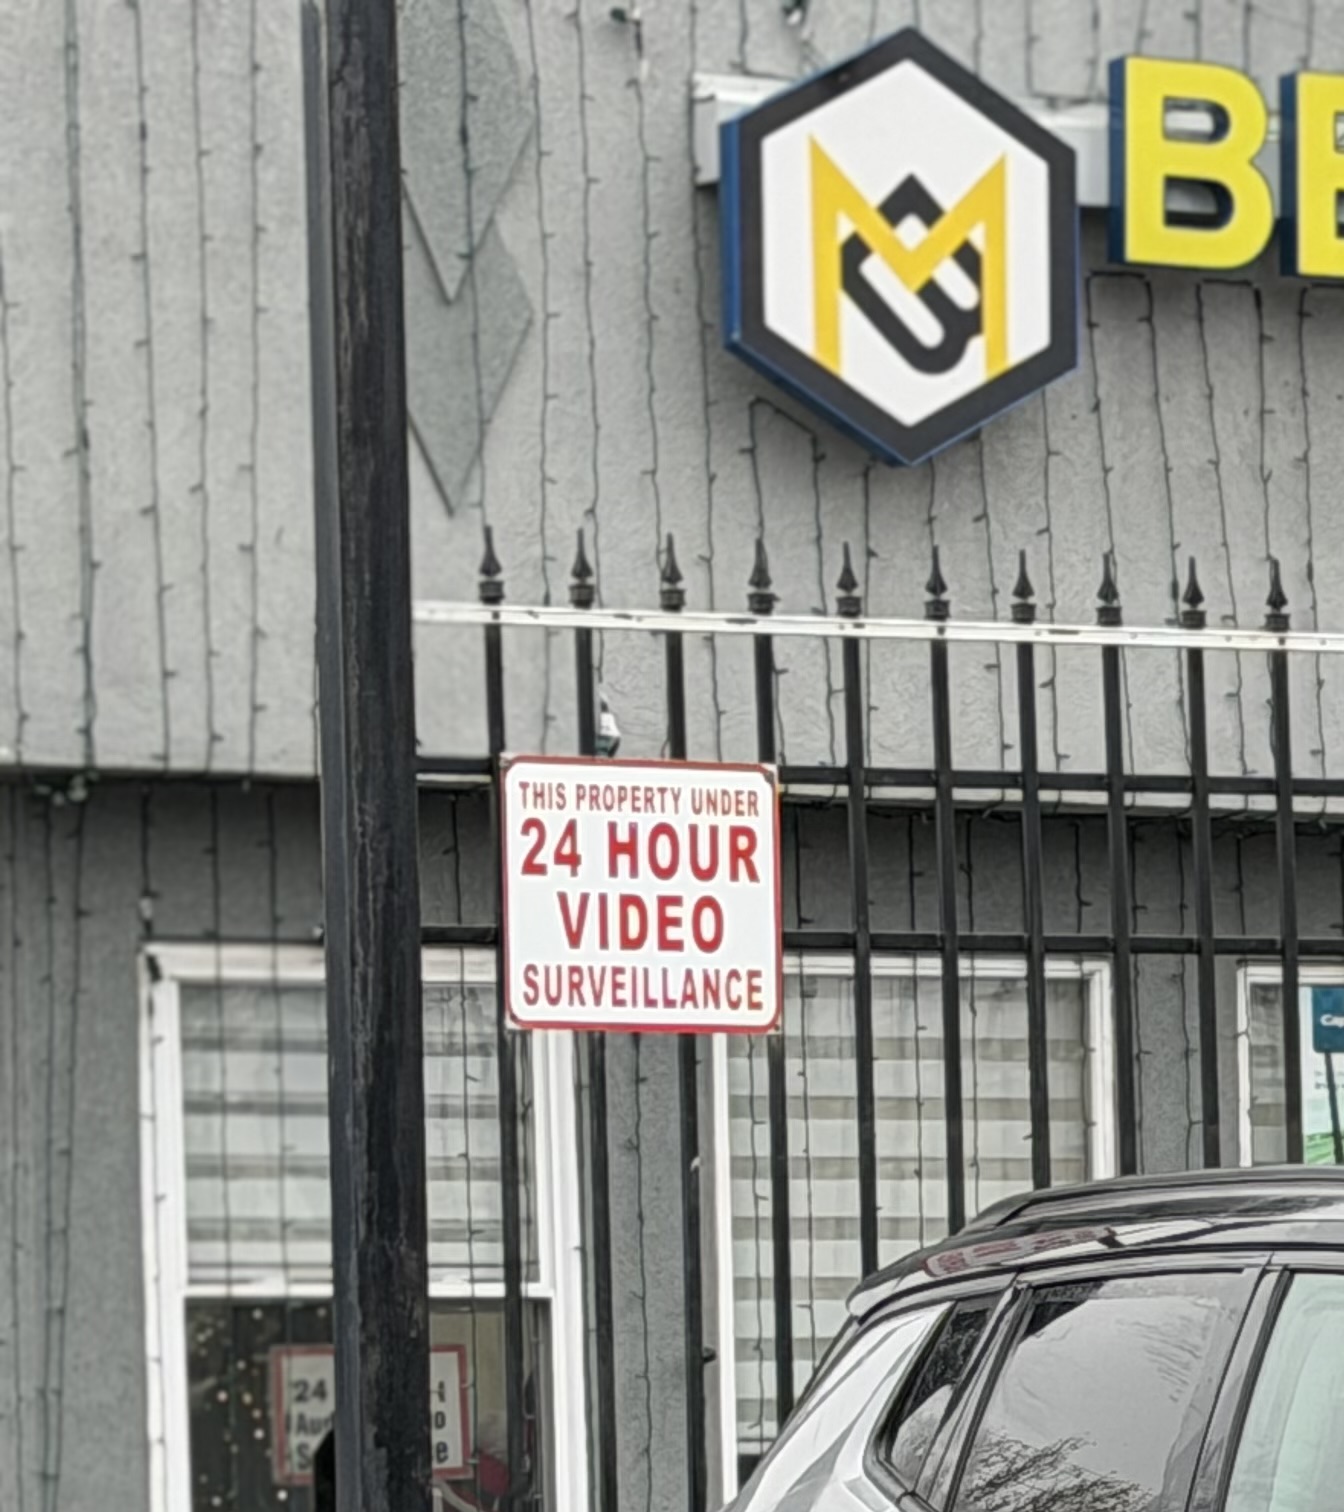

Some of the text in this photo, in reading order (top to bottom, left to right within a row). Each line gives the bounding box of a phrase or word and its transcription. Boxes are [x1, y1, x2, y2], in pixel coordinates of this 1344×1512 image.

[518, 781, 760, 818] THIS PROPERTY UNDER
[519, 817, 761, 884] 24 HOUR
[556, 890, 725, 954] VIDEO
[522, 963, 764, 1011] SURVEILLANCE
[294, 1379, 327, 1403] 24
